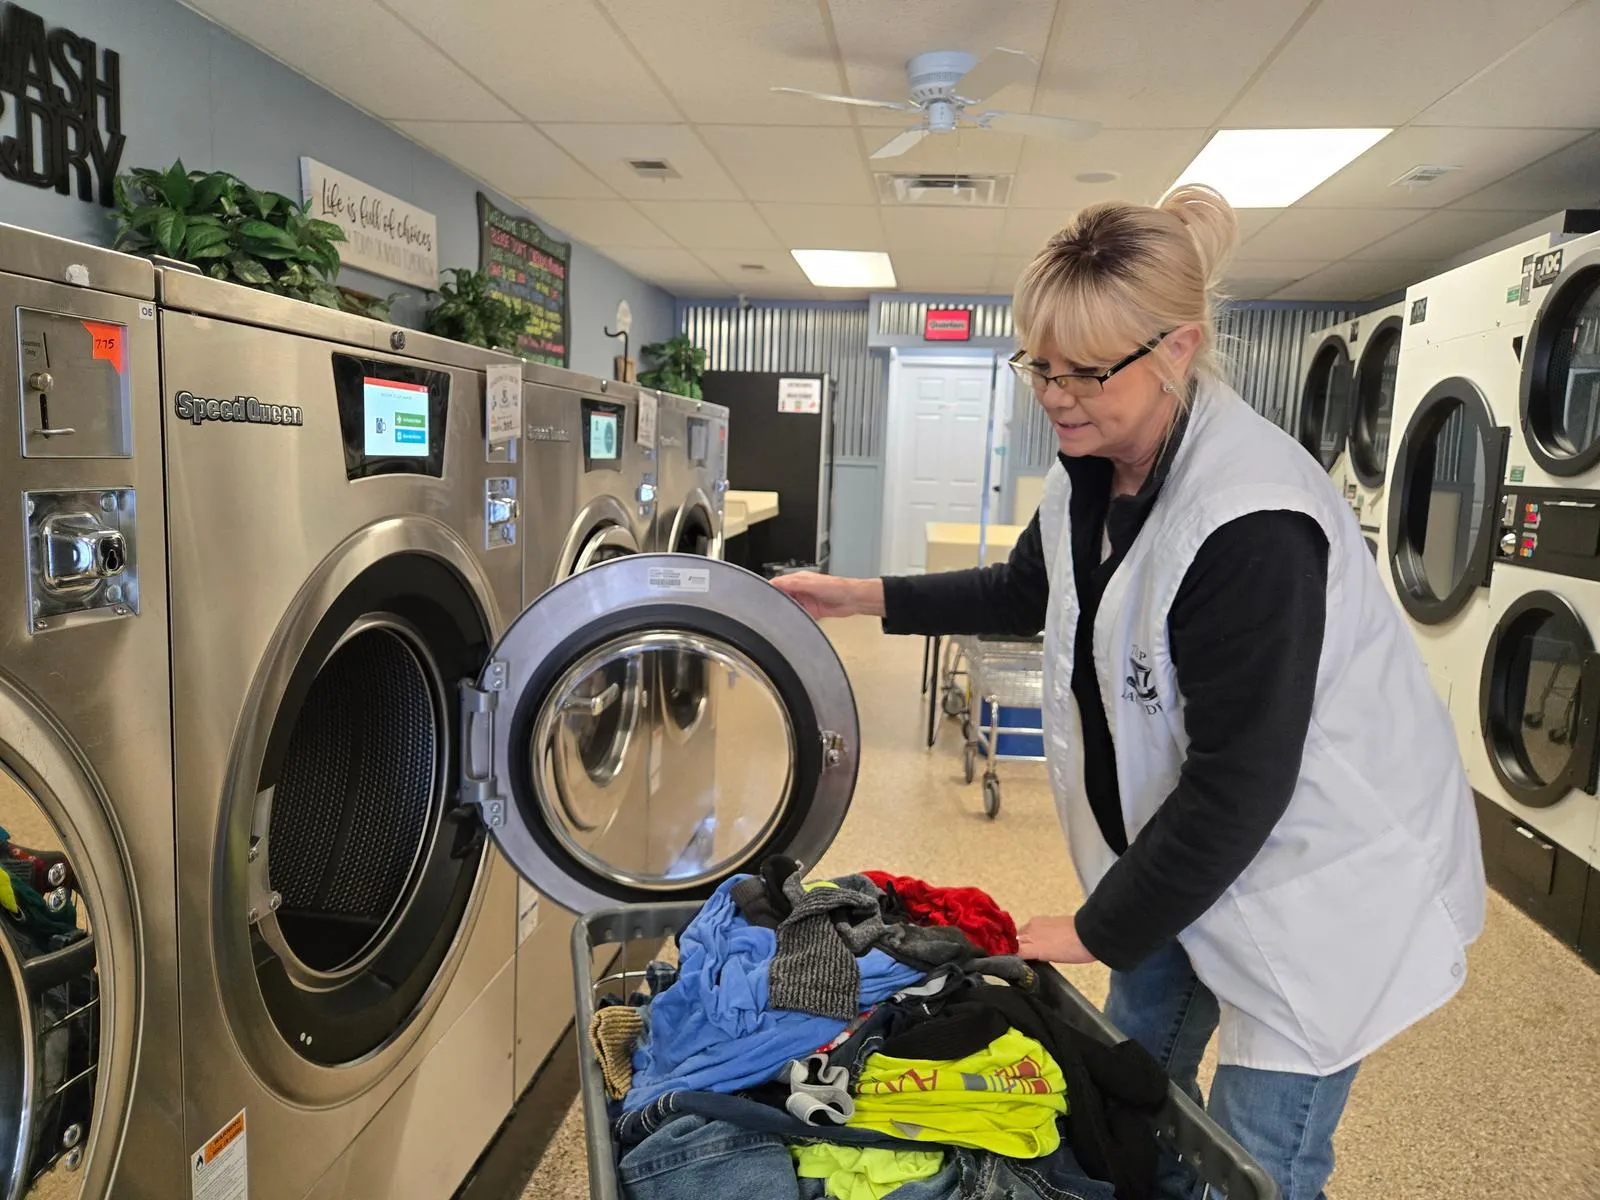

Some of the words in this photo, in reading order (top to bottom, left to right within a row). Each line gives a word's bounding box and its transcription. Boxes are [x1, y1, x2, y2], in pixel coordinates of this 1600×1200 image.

[321, 178, 344, 217] Life
[347, 196, 356, 223] is
[360, 195, 381, 228] full
[383, 208, 395, 240] of
[397, 214, 432, 252] choices
[175, 390, 246, 425] Speed
[246, 396, 303, 426] Queen
